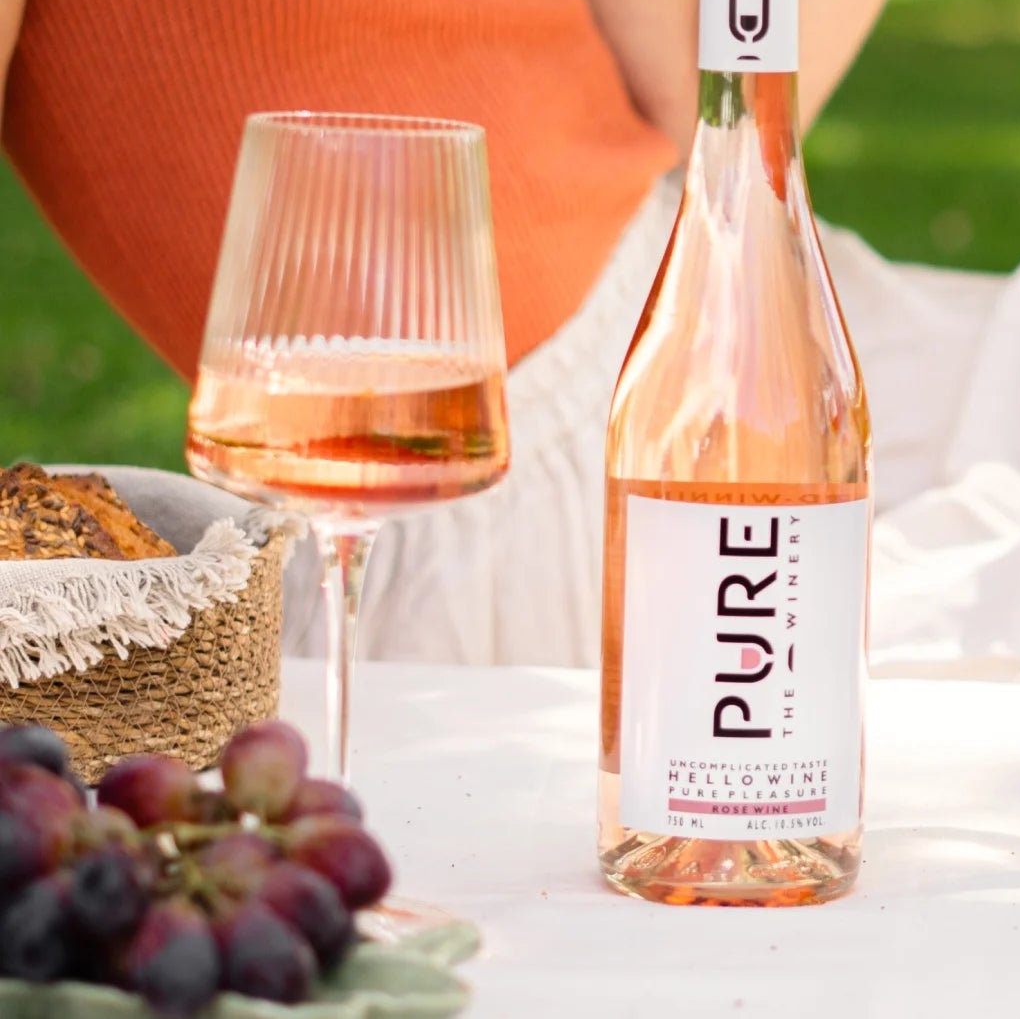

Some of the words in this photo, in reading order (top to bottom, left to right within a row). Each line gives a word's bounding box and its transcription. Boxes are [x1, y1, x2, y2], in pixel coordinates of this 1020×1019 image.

[786, 514, 800, 630] WINERY
[713, 516, 779, 738] PURE
[782, 688, 796, 738] THE
[670, 759, 788, 771] UNCOMPLICATED
[793, 760, 828, 770] TASTE
[669, 770, 754, 786] HELLO
[768, 770, 828, 785] WINE
[669, 786, 718, 798] PURE
[728, 786, 828, 800] PLEASURE
[754, 805, 789, 814] WINE
[668, 815, 684, 826] 750
[691, 818, 704, 828] ML
[746, 820, 772, 830] ALC.
[775, 818, 803, 829] 10.5%
[806, 816, 826, 827] VOL.
